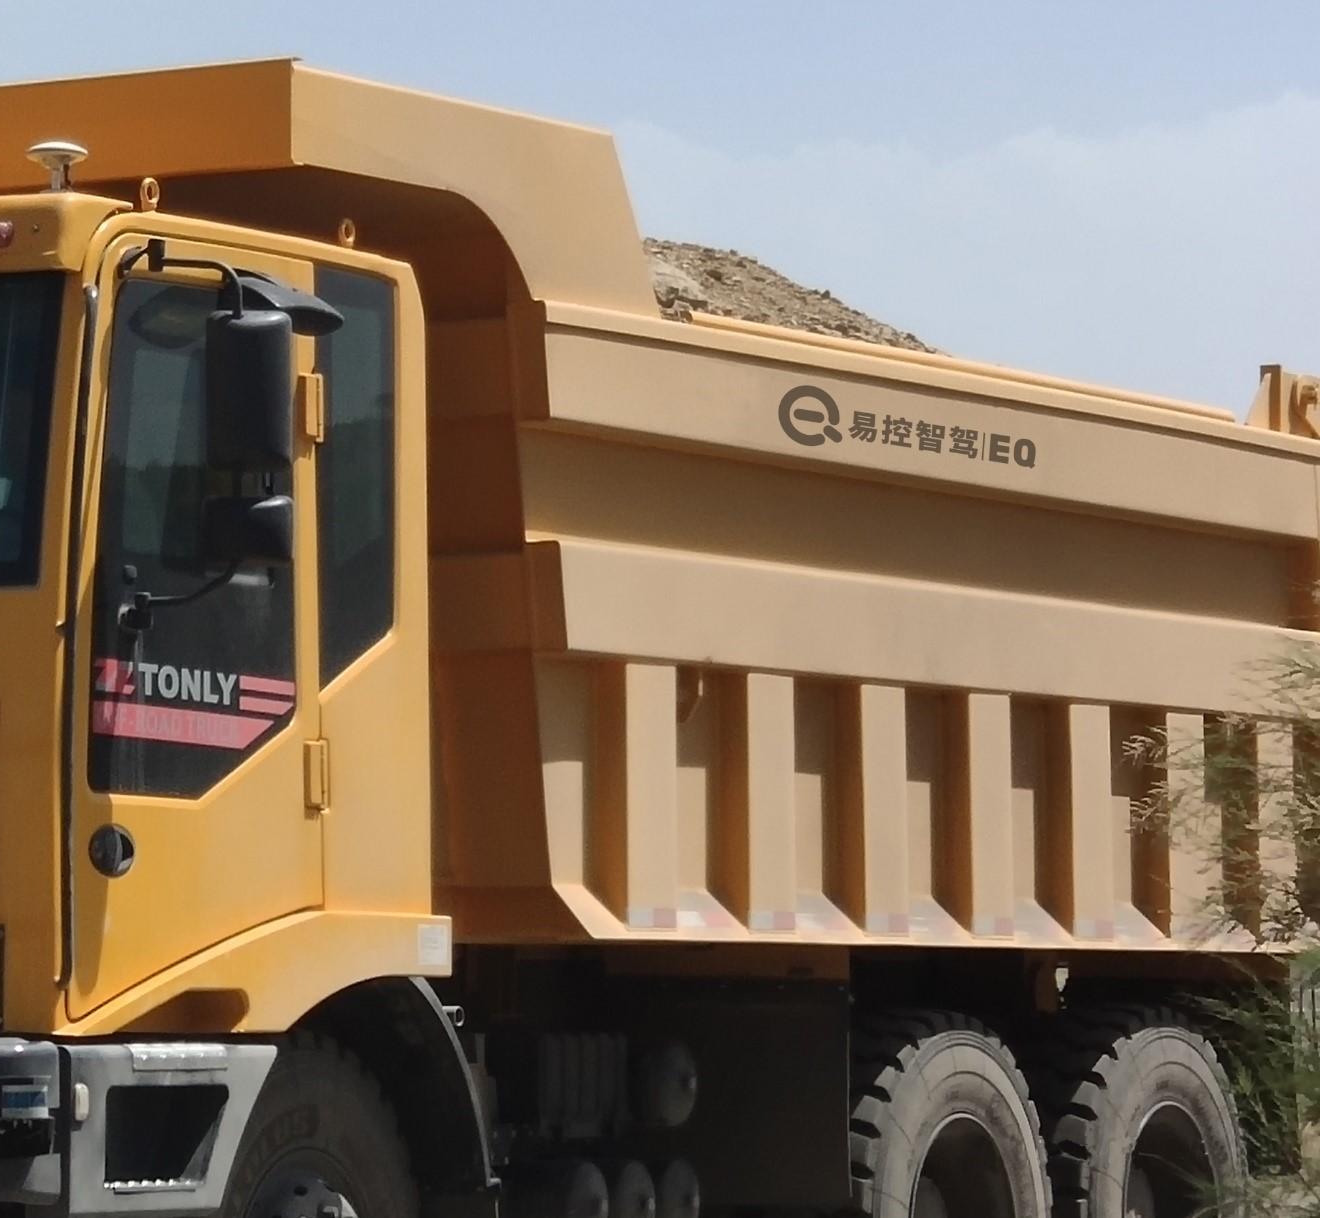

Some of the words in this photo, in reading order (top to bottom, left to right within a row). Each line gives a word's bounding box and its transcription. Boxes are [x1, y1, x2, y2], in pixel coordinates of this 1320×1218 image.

[848, 411, 979, 459] 易控智驾
[989, 433, 1037, 469] EQ
[138, 662, 238, 706] TONLY
